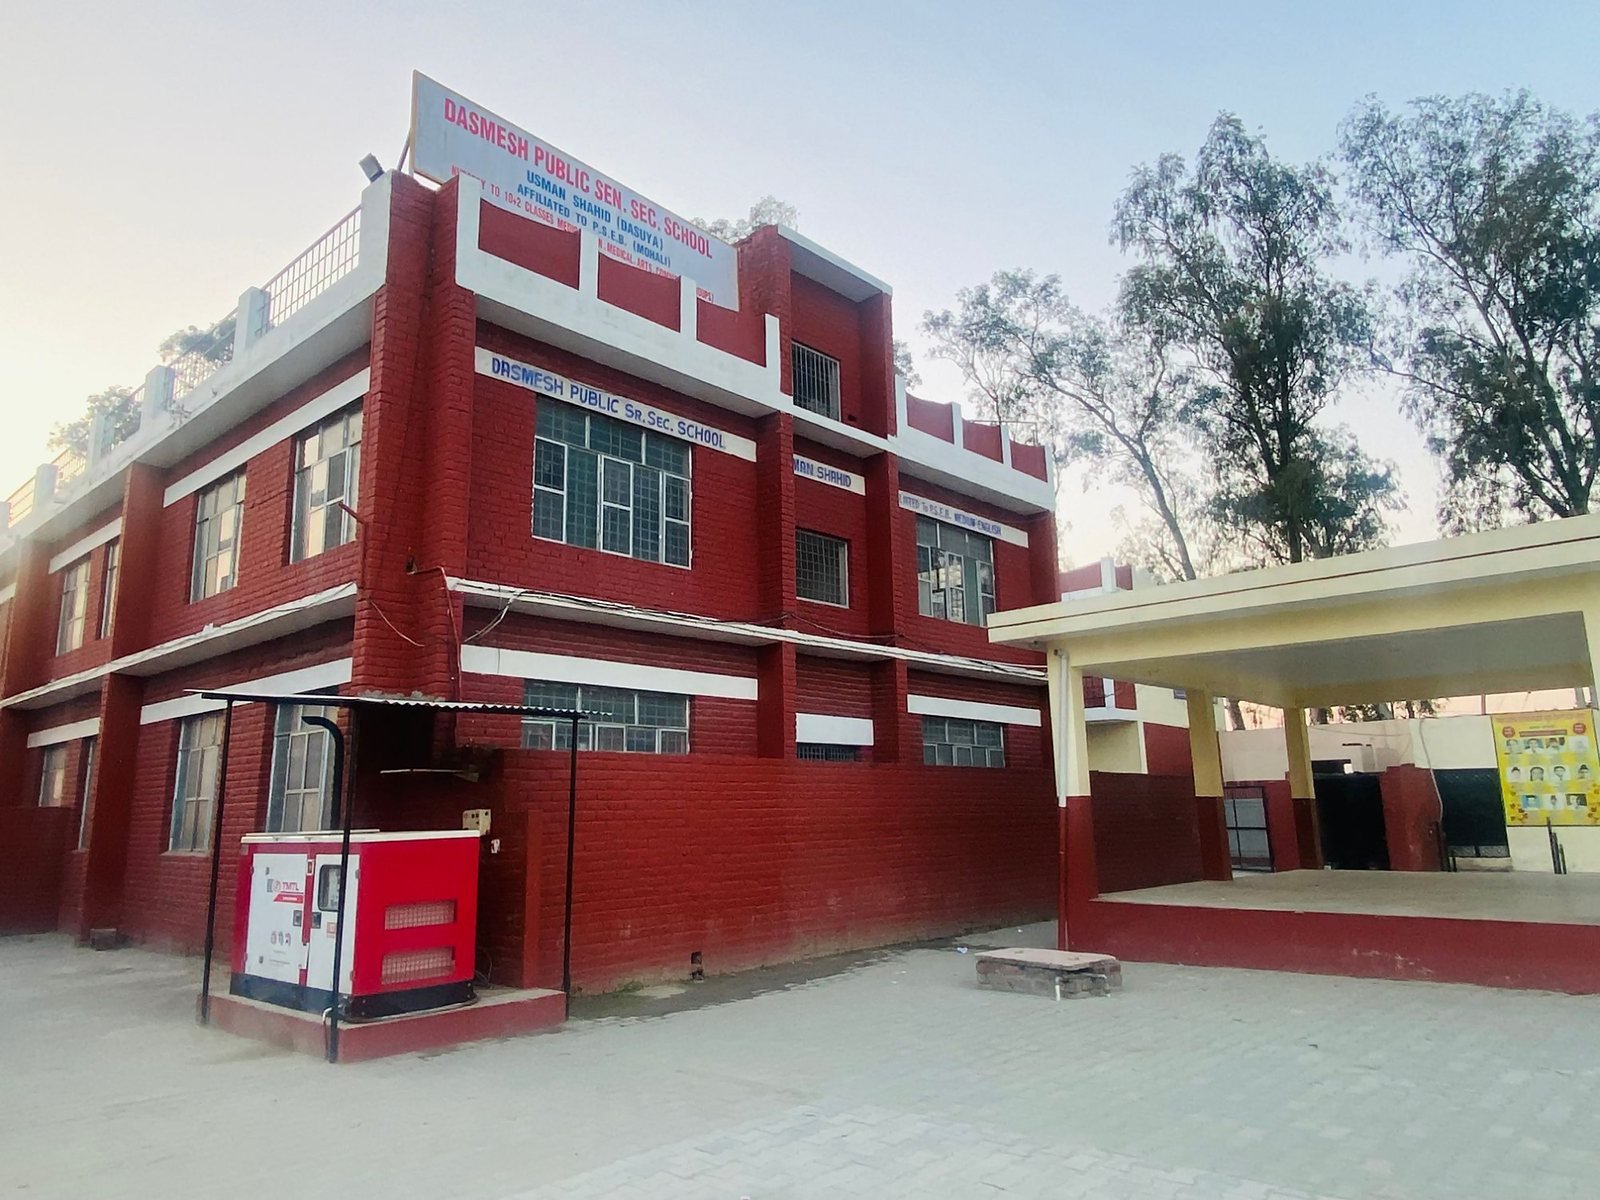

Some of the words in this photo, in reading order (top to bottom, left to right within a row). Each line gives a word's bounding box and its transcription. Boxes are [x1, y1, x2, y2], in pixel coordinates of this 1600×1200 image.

[445, 98, 528, 160] DASMESH
[534, 145, 590, 193] PUBLIC
[595, 179, 627, 213] SEN.
[631, 199, 661, 231] SEC.
[664, 216, 713, 259] SCHOOL
[491, 183, 500, 197] TO
[504, 191, 522, 208] 10+2
[524, 201, 554, 224] CLASSES
[526, 170, 566, 200] USMAN
[573, 194, 611, 223] SHAHID
[617, 215, 663, 251] (DASUYA)
[517, 184, 570, 218] AFFILIATED
[576, 211, 588, 226] TO
[633, 240, 671, 268] (MOHALI)
[491, 357, 564, 396] DASMESH
[570, 384, 620, 413] PUBLIC
[677, 421, 727, 449] SCHOOL
[817, 466, 852, 488] SHAHID
